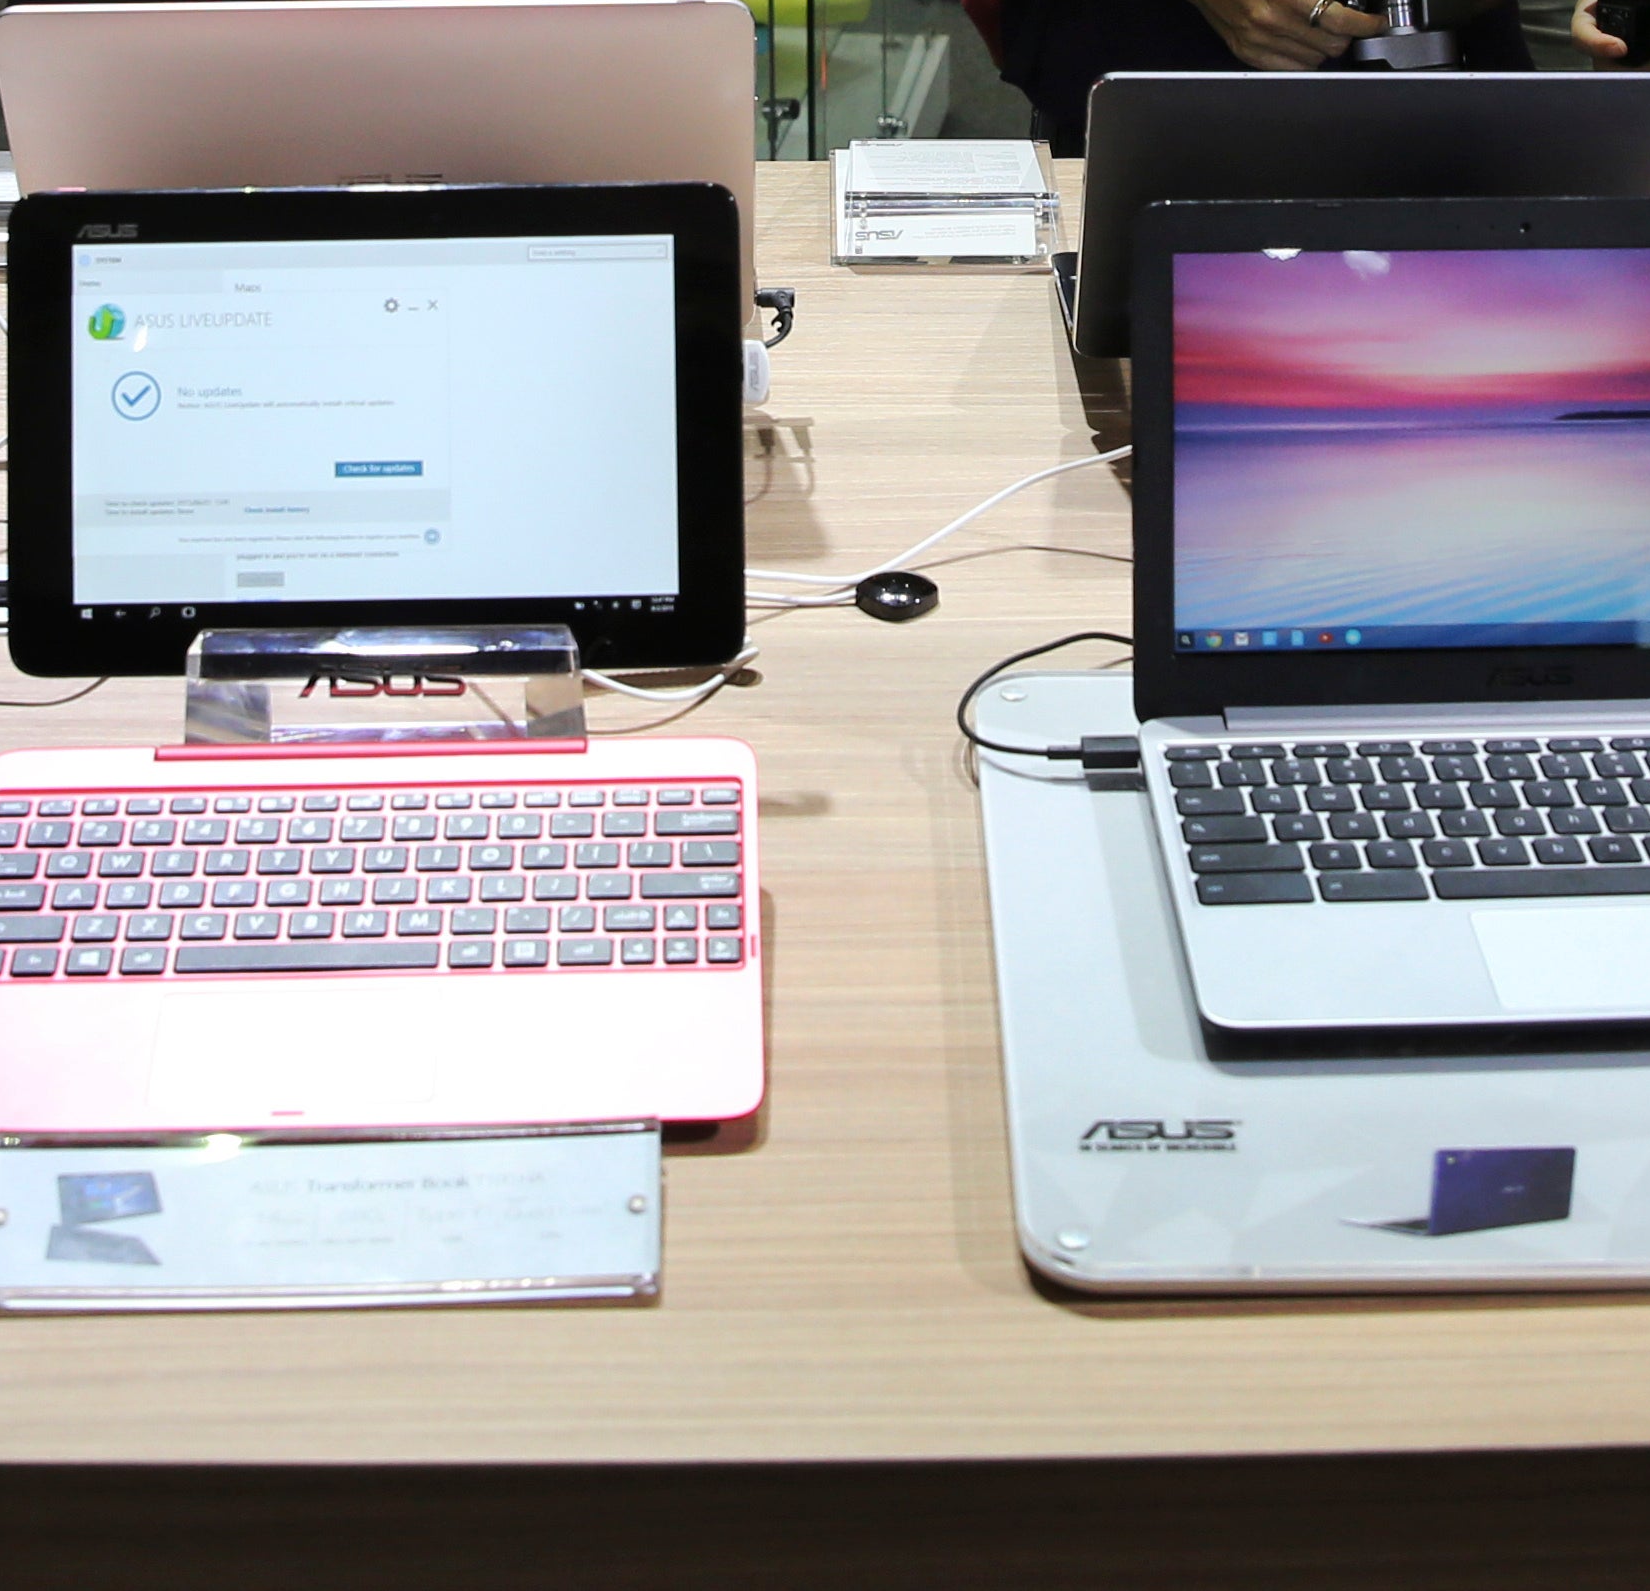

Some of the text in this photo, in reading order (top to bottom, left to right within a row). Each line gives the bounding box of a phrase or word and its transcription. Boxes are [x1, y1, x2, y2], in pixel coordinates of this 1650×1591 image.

[77, 223, 138, 239] ASUS
[855, 229, 904, 242] ASUS
[234, 282, 261, 295] Maps
[134, 311, 273, 329] ASUS LIVEUPDATE
[177, 385, 243, 400] No updates
[343, 463, 416, 475] Check for updates
[299, 665, 470, 699] ASUS
[1486, 664, 1573, 687] ASUS
[1080, 1120, 1236, 1141] ASUS
